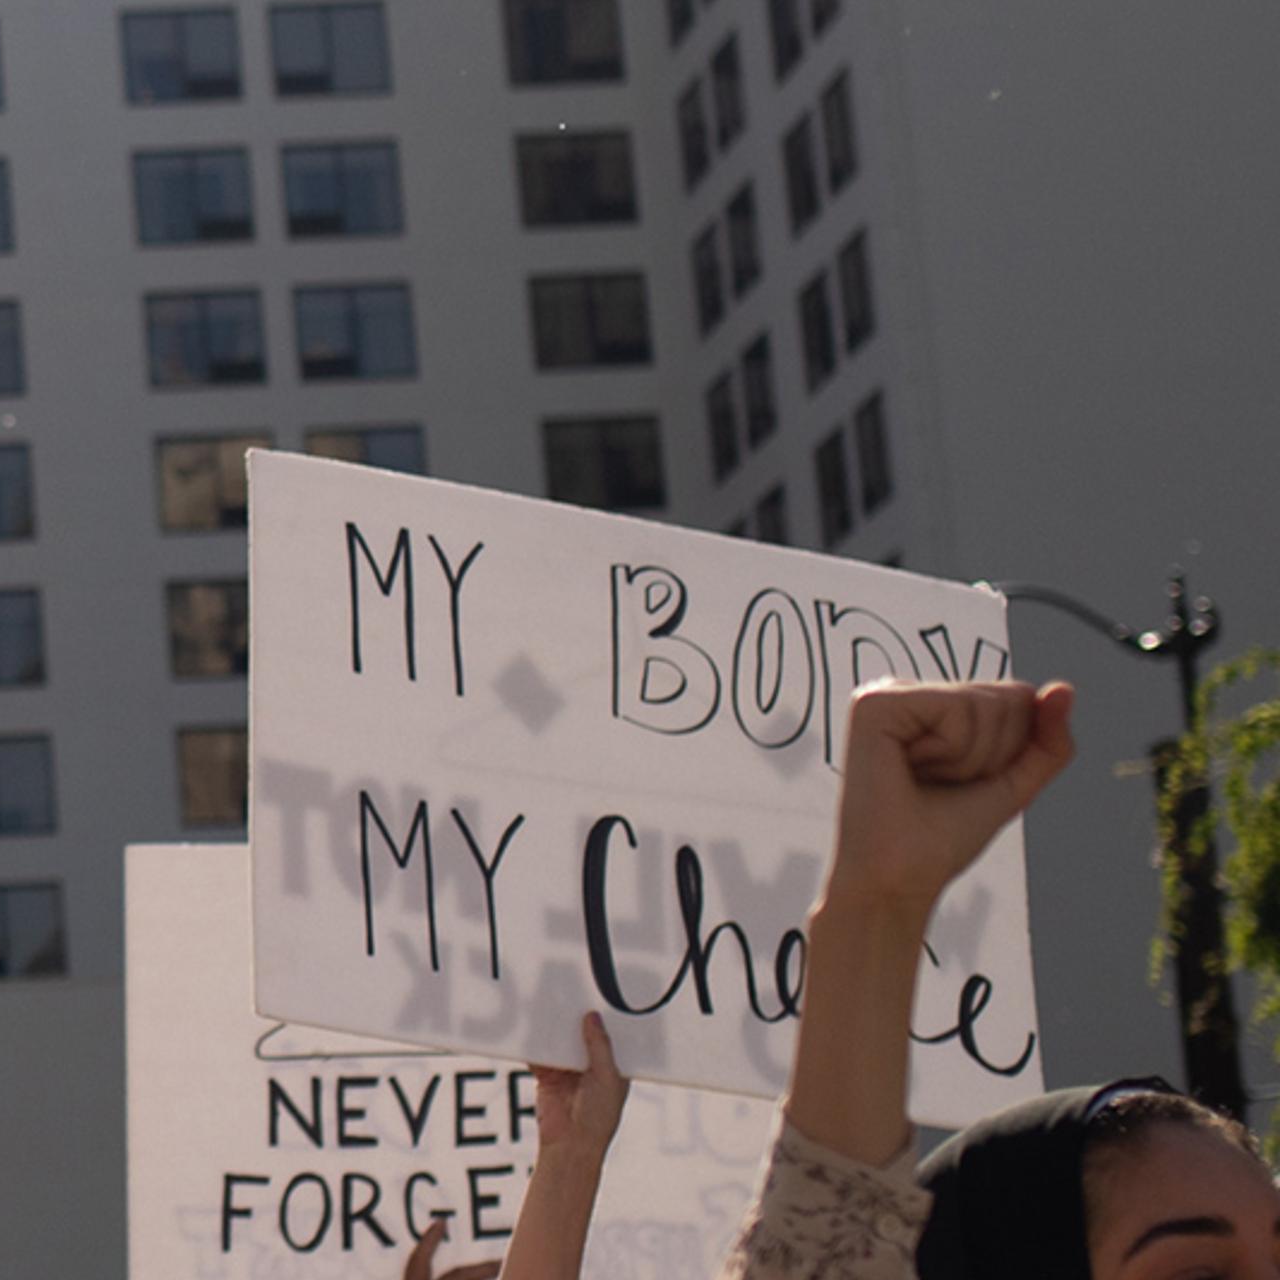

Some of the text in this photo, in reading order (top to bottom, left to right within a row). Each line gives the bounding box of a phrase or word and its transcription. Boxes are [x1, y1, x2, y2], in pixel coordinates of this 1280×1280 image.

[345, 521, 485, 698] MY
[359, 789, 1036, 1075] MY Choe
[221, 1163, 532, 1253] FORGE
